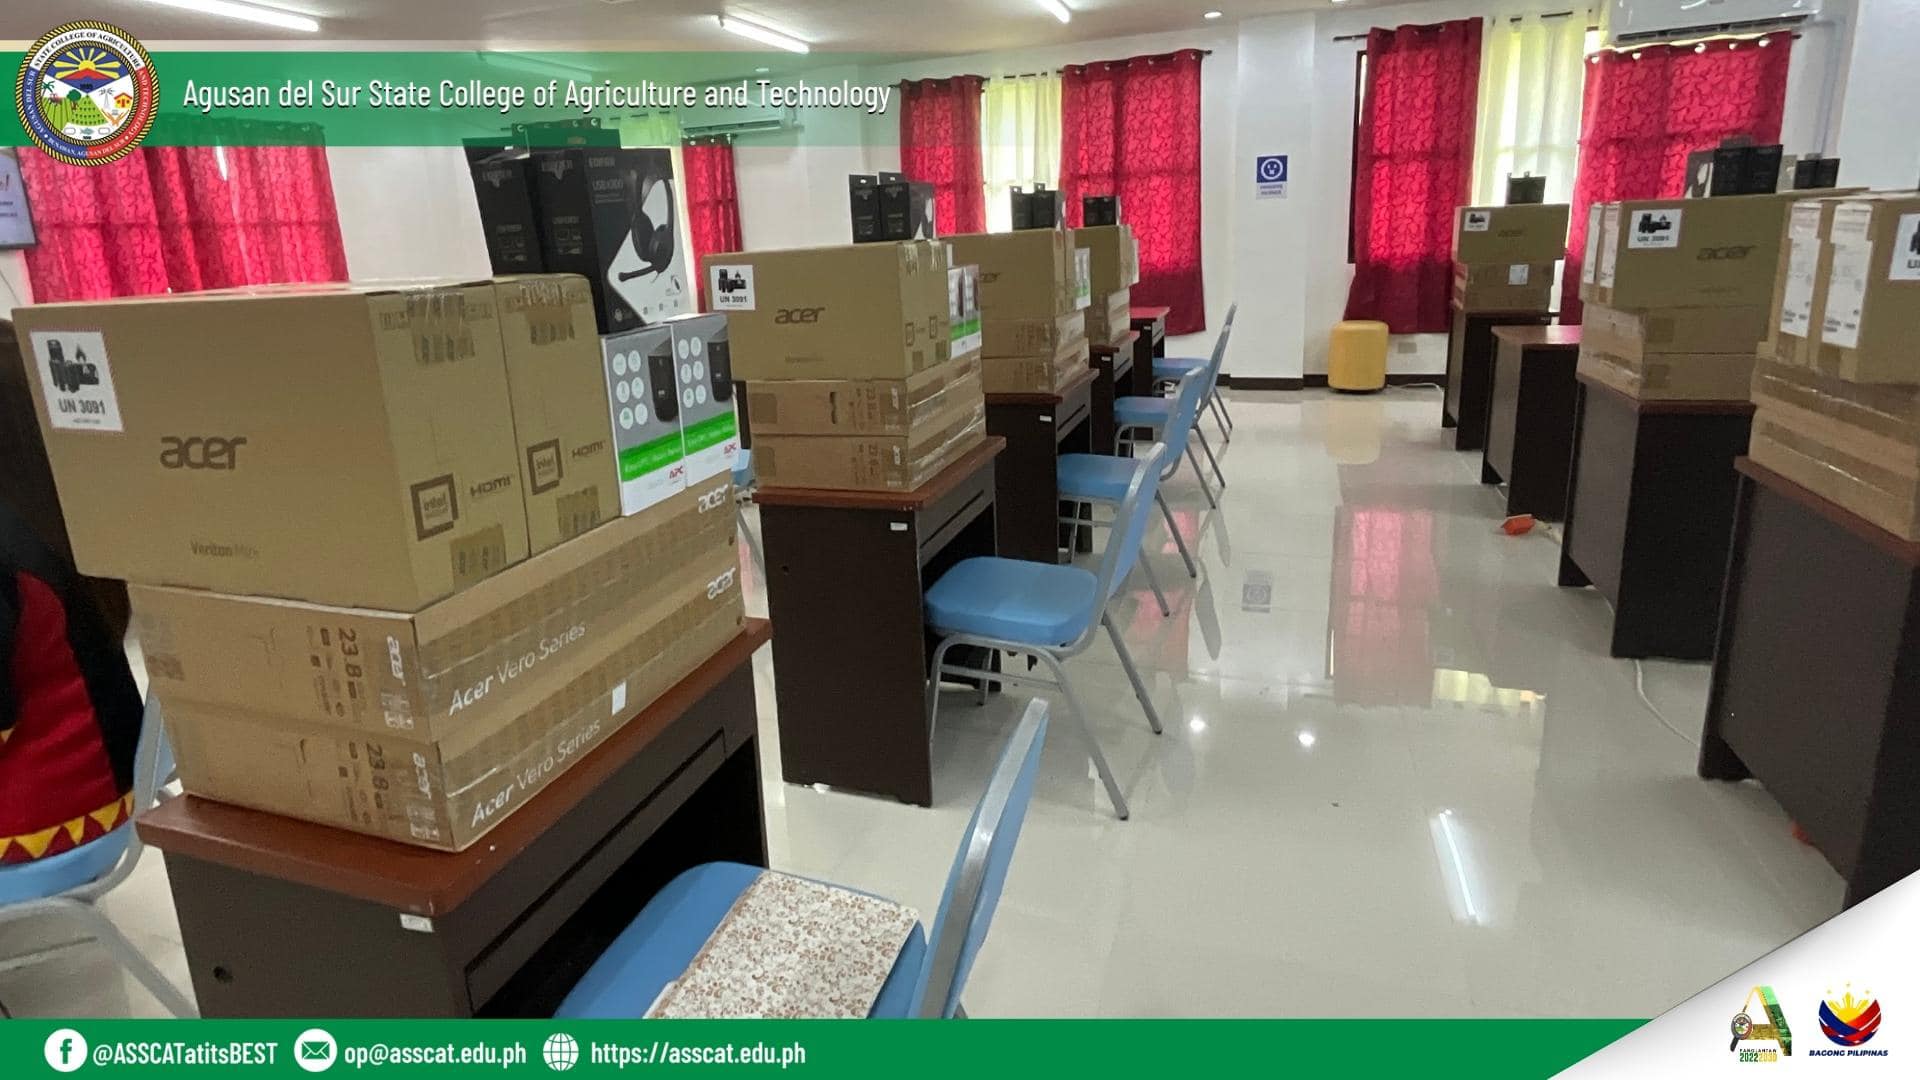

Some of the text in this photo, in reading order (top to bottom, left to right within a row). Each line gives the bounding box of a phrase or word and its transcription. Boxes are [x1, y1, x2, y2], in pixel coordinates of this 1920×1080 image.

[1696, 245, 1755, 261] acer
[774, 307, 826, 325] acer
[58, 399, 106, 415] UN 3091
[160, 436, 248, 470] acer
[698, 484, 729, 513] acer
[706, 568, 736, 600] acer
[449, 622, 587, 717] Acer Vero Series
[471, 719, 601, 829] Acer Vero Series
